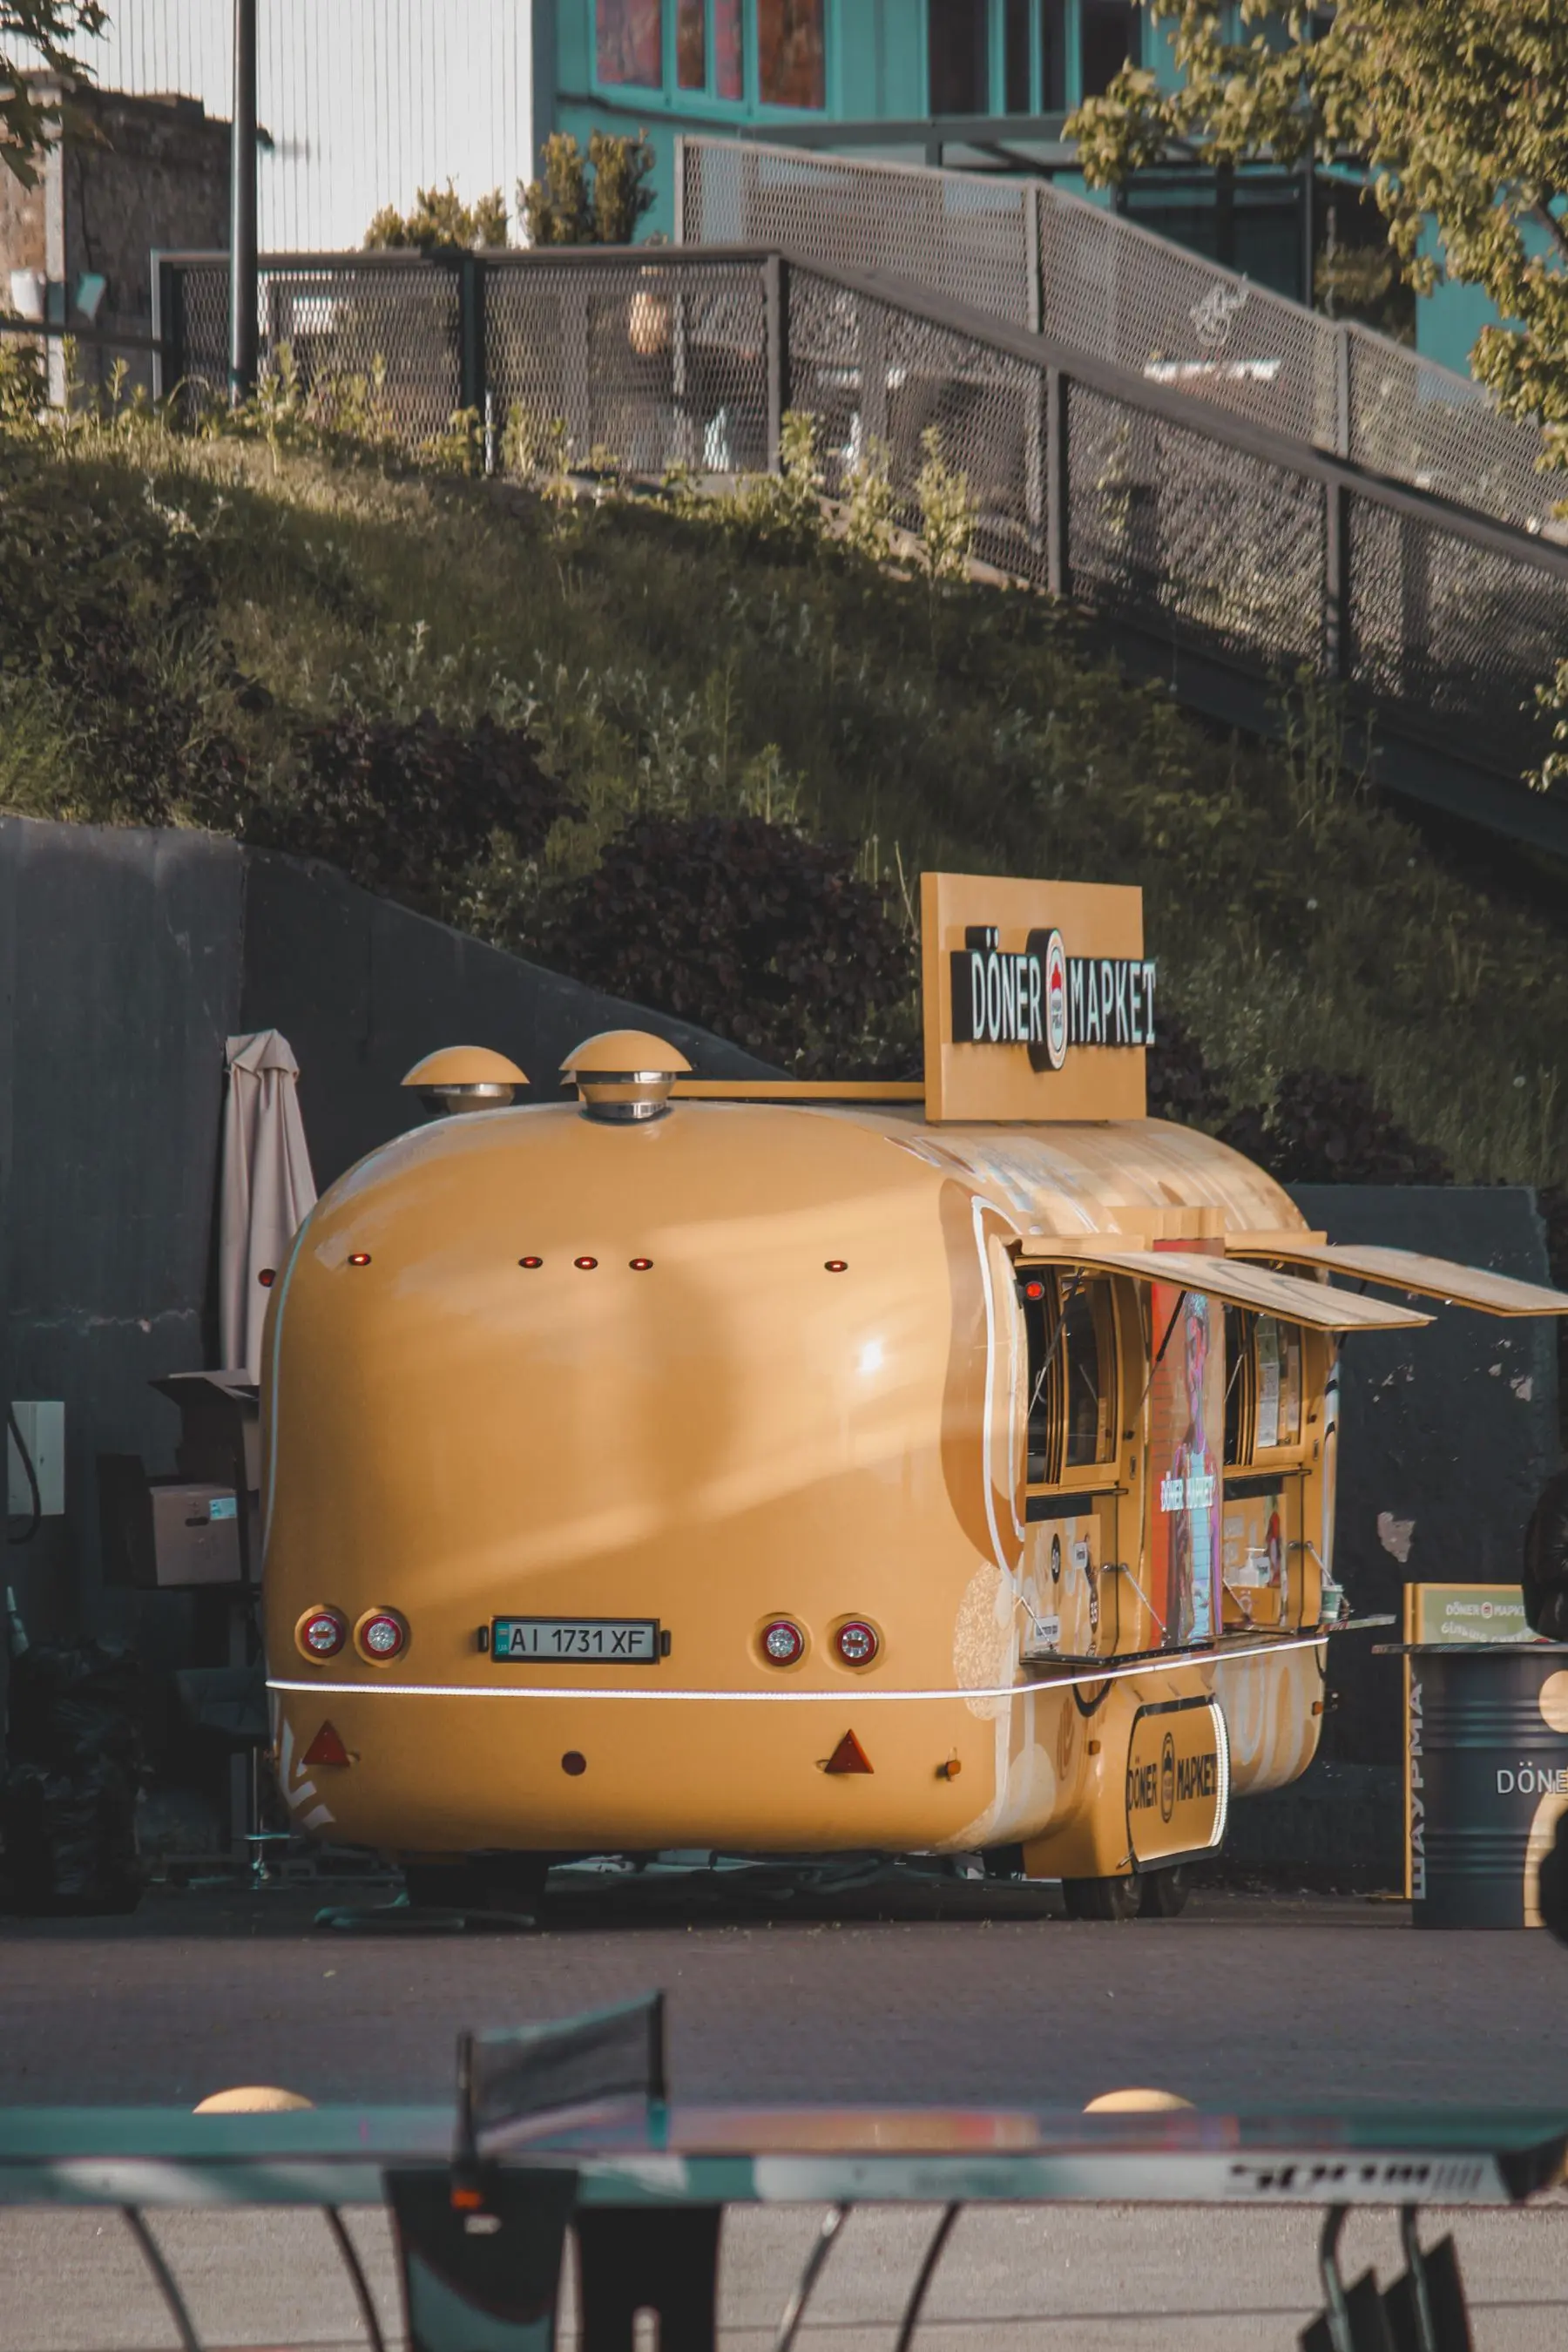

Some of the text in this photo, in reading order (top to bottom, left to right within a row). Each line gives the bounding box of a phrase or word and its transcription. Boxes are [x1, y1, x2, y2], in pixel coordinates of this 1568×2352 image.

[971, 927, 1157, 1044] DÖNER МАРКЕТ
[1446, 1601, 1480, 1616] DÖNER
[510, 1628, 645, 1654] AI 1731 XF
[1128, 1755, 1158, 1811] DÖNER
[1410, 1683, 1427, 1900] ШАУРМА
